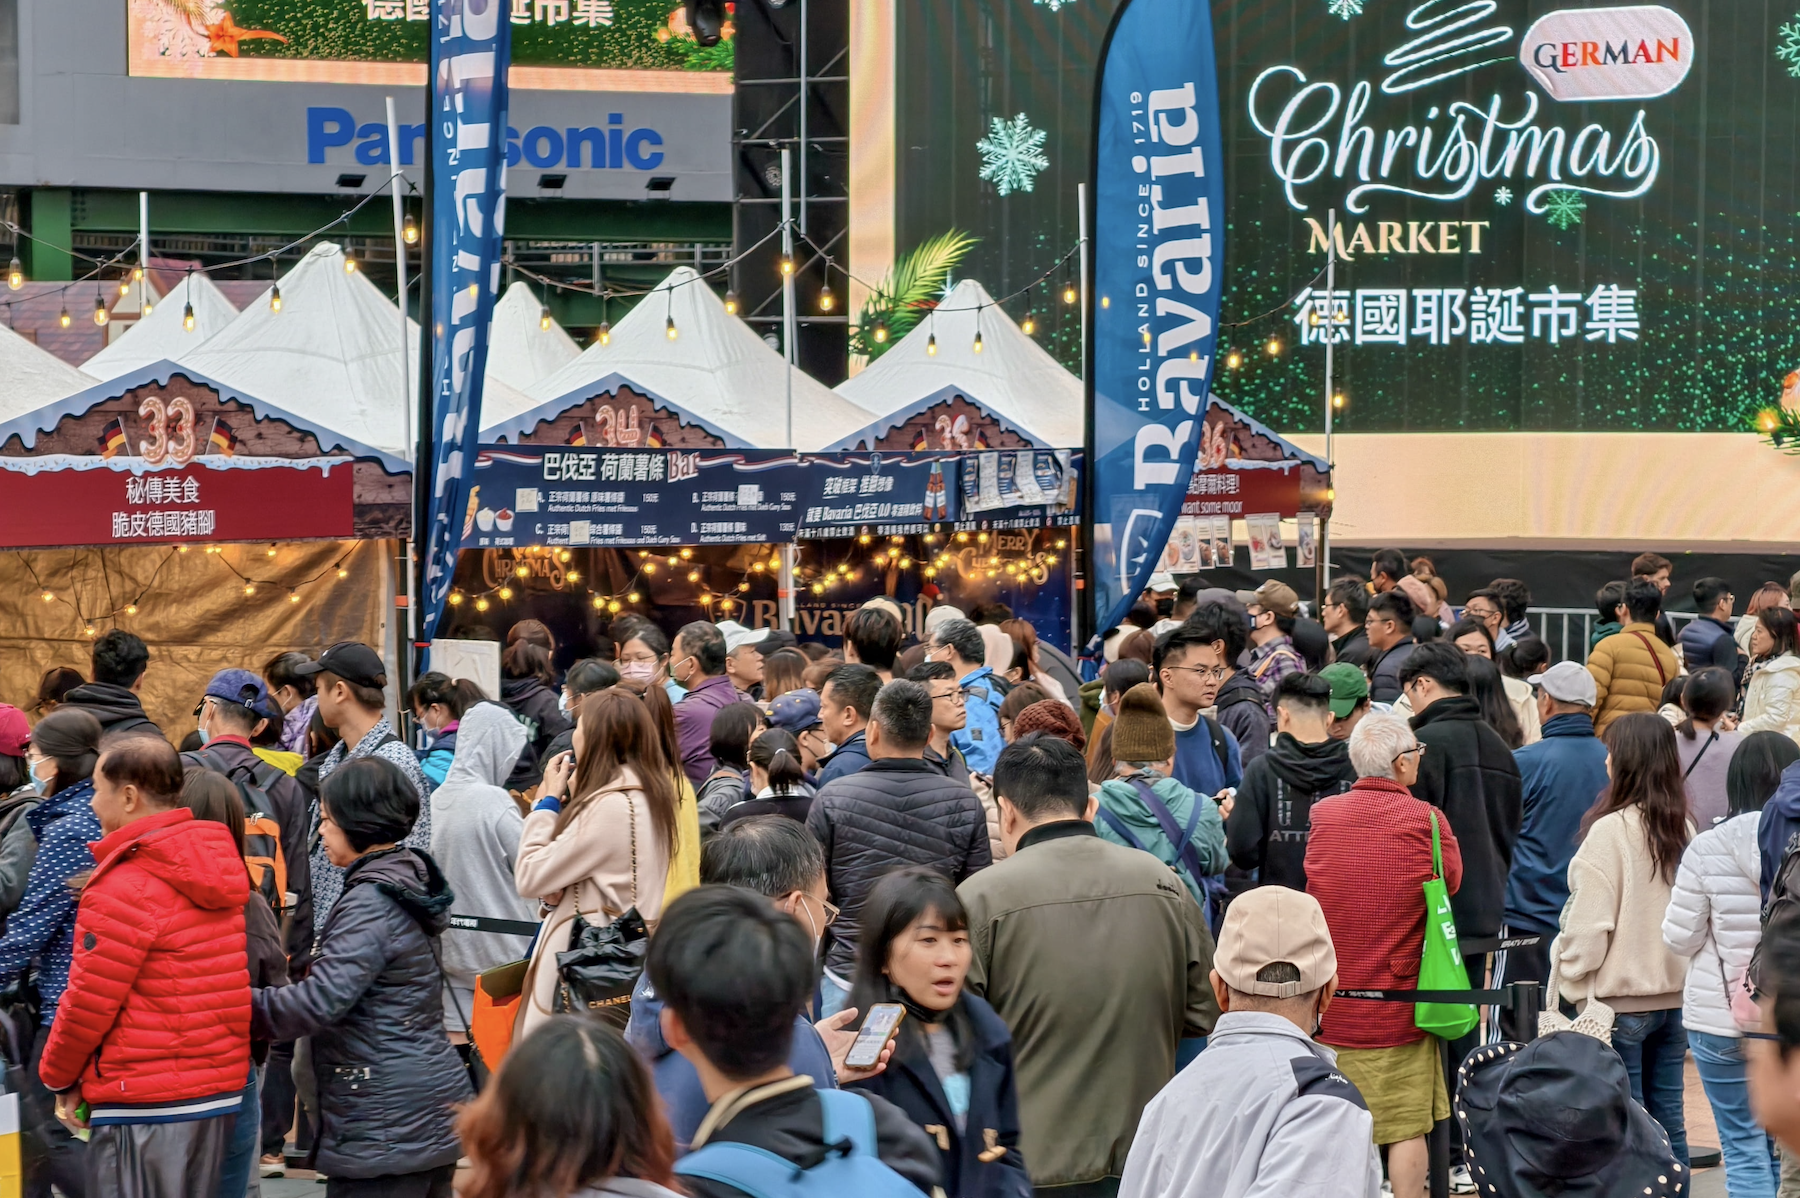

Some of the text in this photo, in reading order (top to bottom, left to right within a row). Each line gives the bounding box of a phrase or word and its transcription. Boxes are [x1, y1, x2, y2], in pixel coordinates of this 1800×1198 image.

[1533, 37, 1680, 73] GERMAN
[1248, 65, 1660, 214] Christmas
[1130, 91, 1151, 412] HOLLAND SINCE 1719
[1303, 216, 1490, 262] MARKET
[1133, 82, 1213, 490] Bavaria
[1293, 283, 1641, 346] 德國耶誕市集
[139, 396, 196, 466] 33
[595, 404, 641, 447] 34
[543, 451, 700, 483] 巴伐亞 荷蘭薯條 Bar
[125, 475, 201, 505] 秘傳美食
[1201, 501, 1221, 514] some
[111, 509, 216, 538] 脆皮德國豬腳
[822, 505, 853, 521] Bavaria
